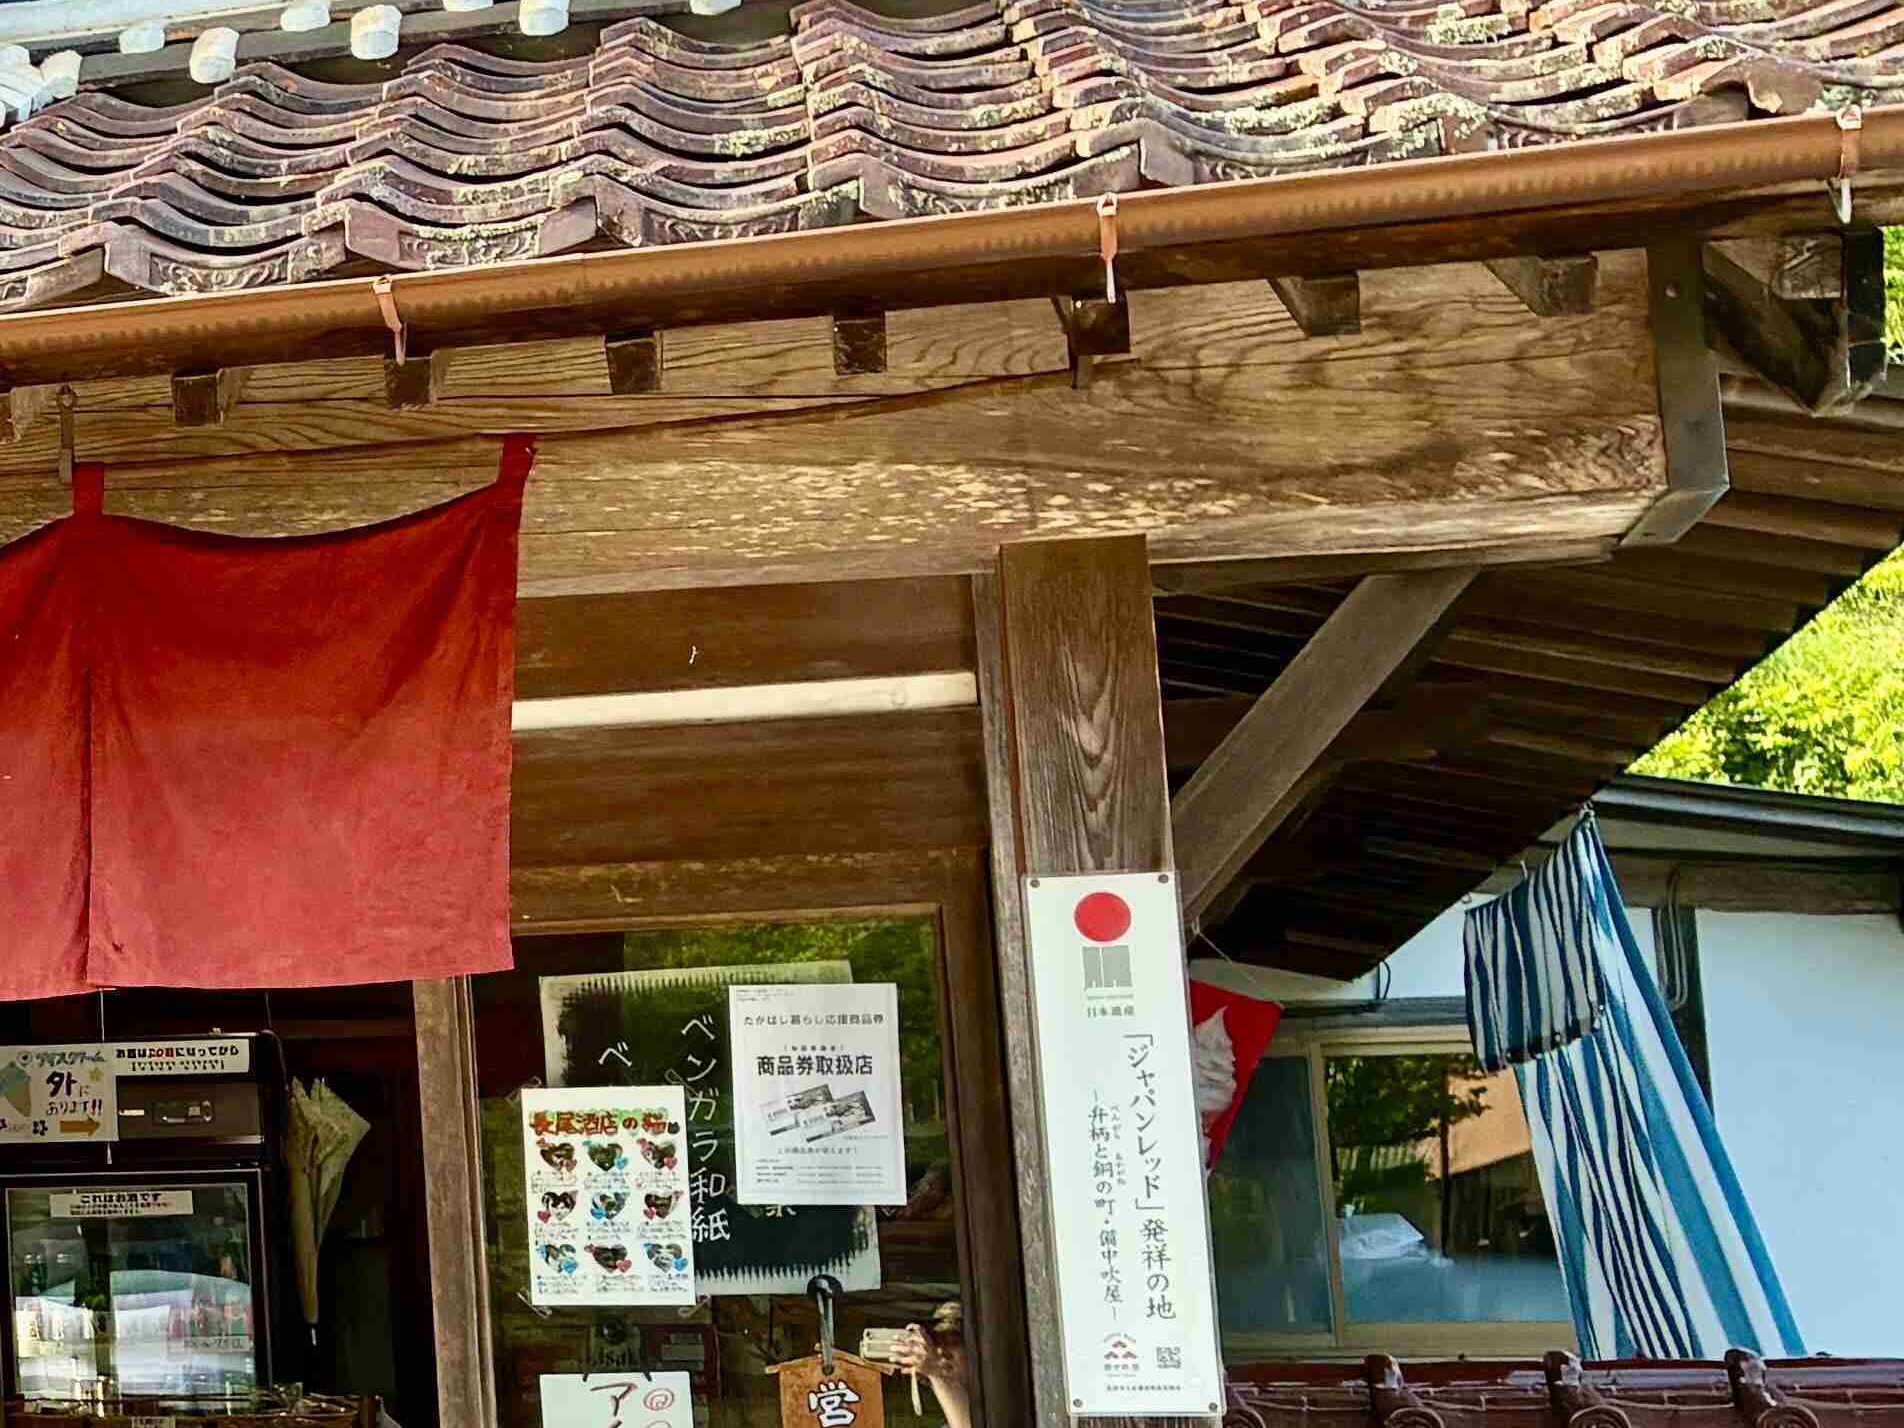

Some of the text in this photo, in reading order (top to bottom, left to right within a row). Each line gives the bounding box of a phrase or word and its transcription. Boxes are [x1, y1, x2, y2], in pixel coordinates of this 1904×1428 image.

[757, 1055, 873, 1076] 商品券取扱店
[1123, 1034, 1176, 1319] 「ジャパンレッド」発祥の地
